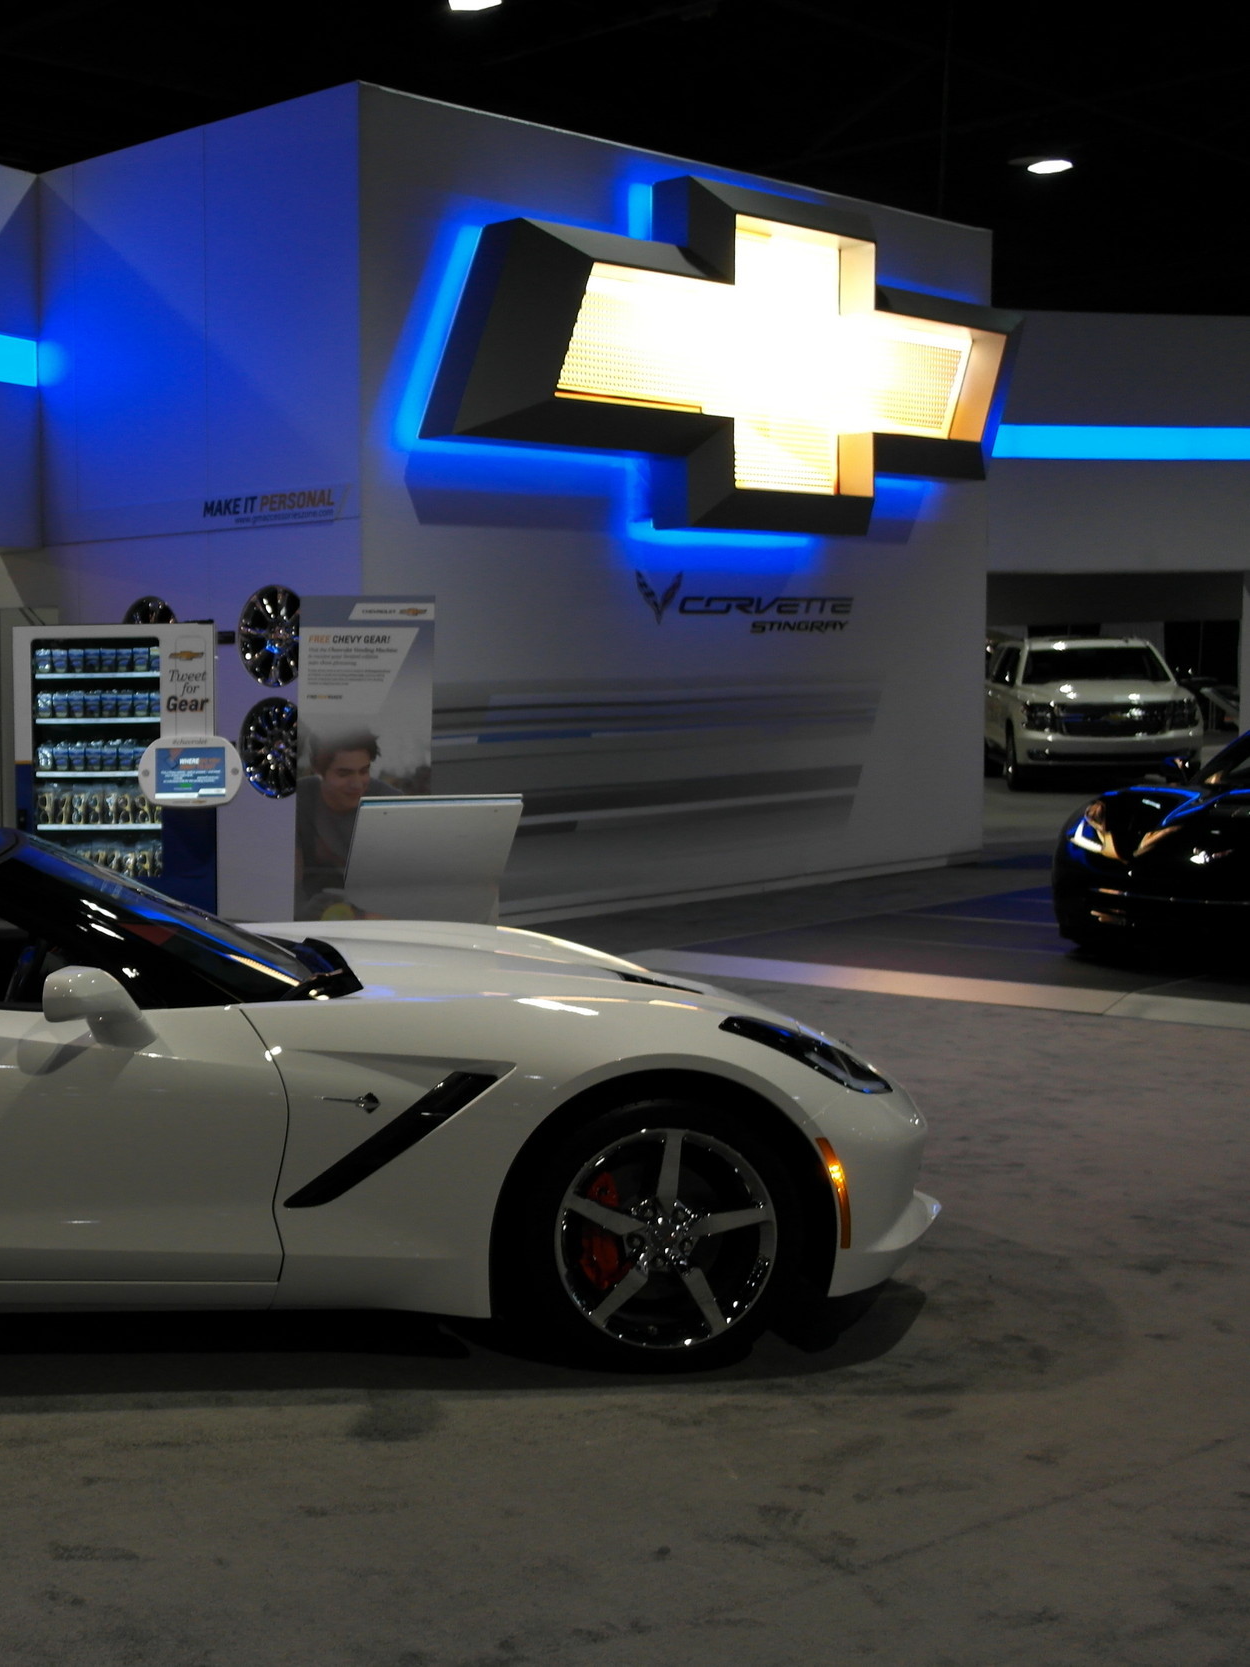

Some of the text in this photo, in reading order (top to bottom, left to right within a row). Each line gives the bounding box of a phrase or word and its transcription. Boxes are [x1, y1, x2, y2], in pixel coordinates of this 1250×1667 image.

[203, 489, 334, 518] MAKE IT PERSONAL
[679, 597, 853, 614] CORVETTE
[751, 620, 848, 633] STINGRAY
[308, 635, 391, 644] FREE CHEVY GEAR!
[169, 669, 207, 682] Tweet
[180, 682, 200, 697] for
[166, 695, 209, 712] Gear
